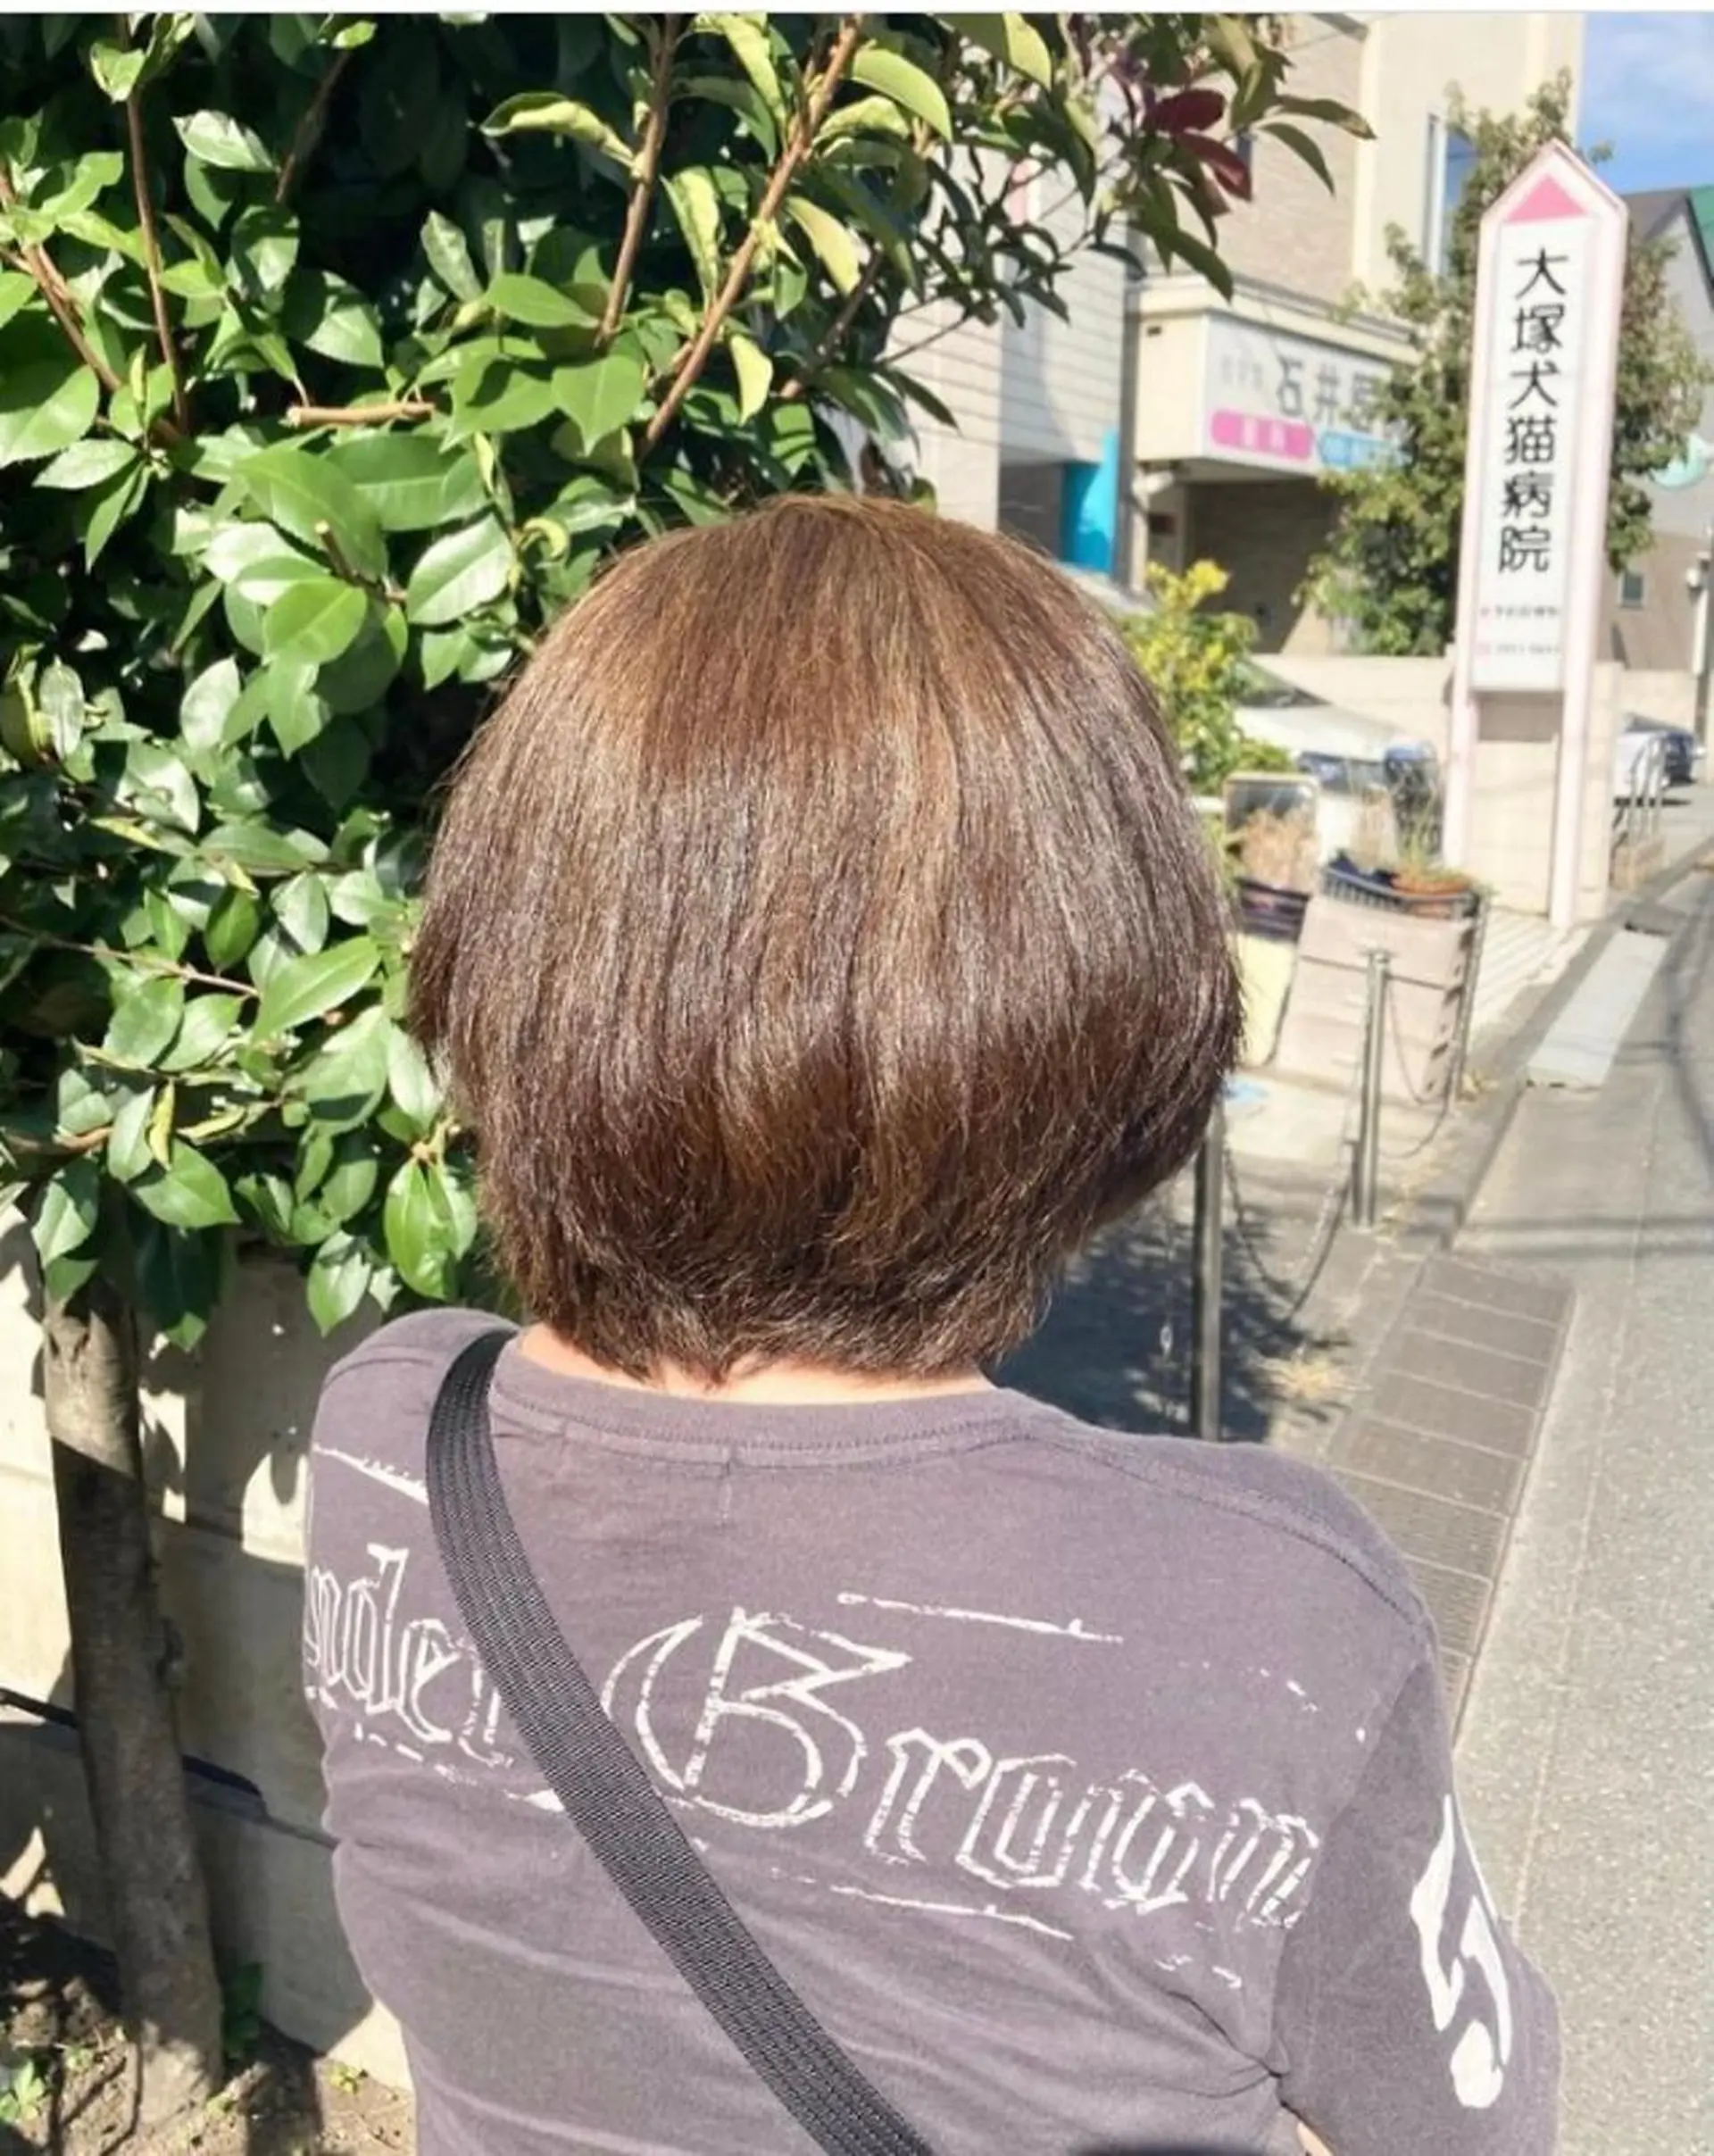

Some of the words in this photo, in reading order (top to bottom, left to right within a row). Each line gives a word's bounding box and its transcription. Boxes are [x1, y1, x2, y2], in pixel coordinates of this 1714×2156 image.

[1499, 247, 1569, 572] 大塚犬猫病院
